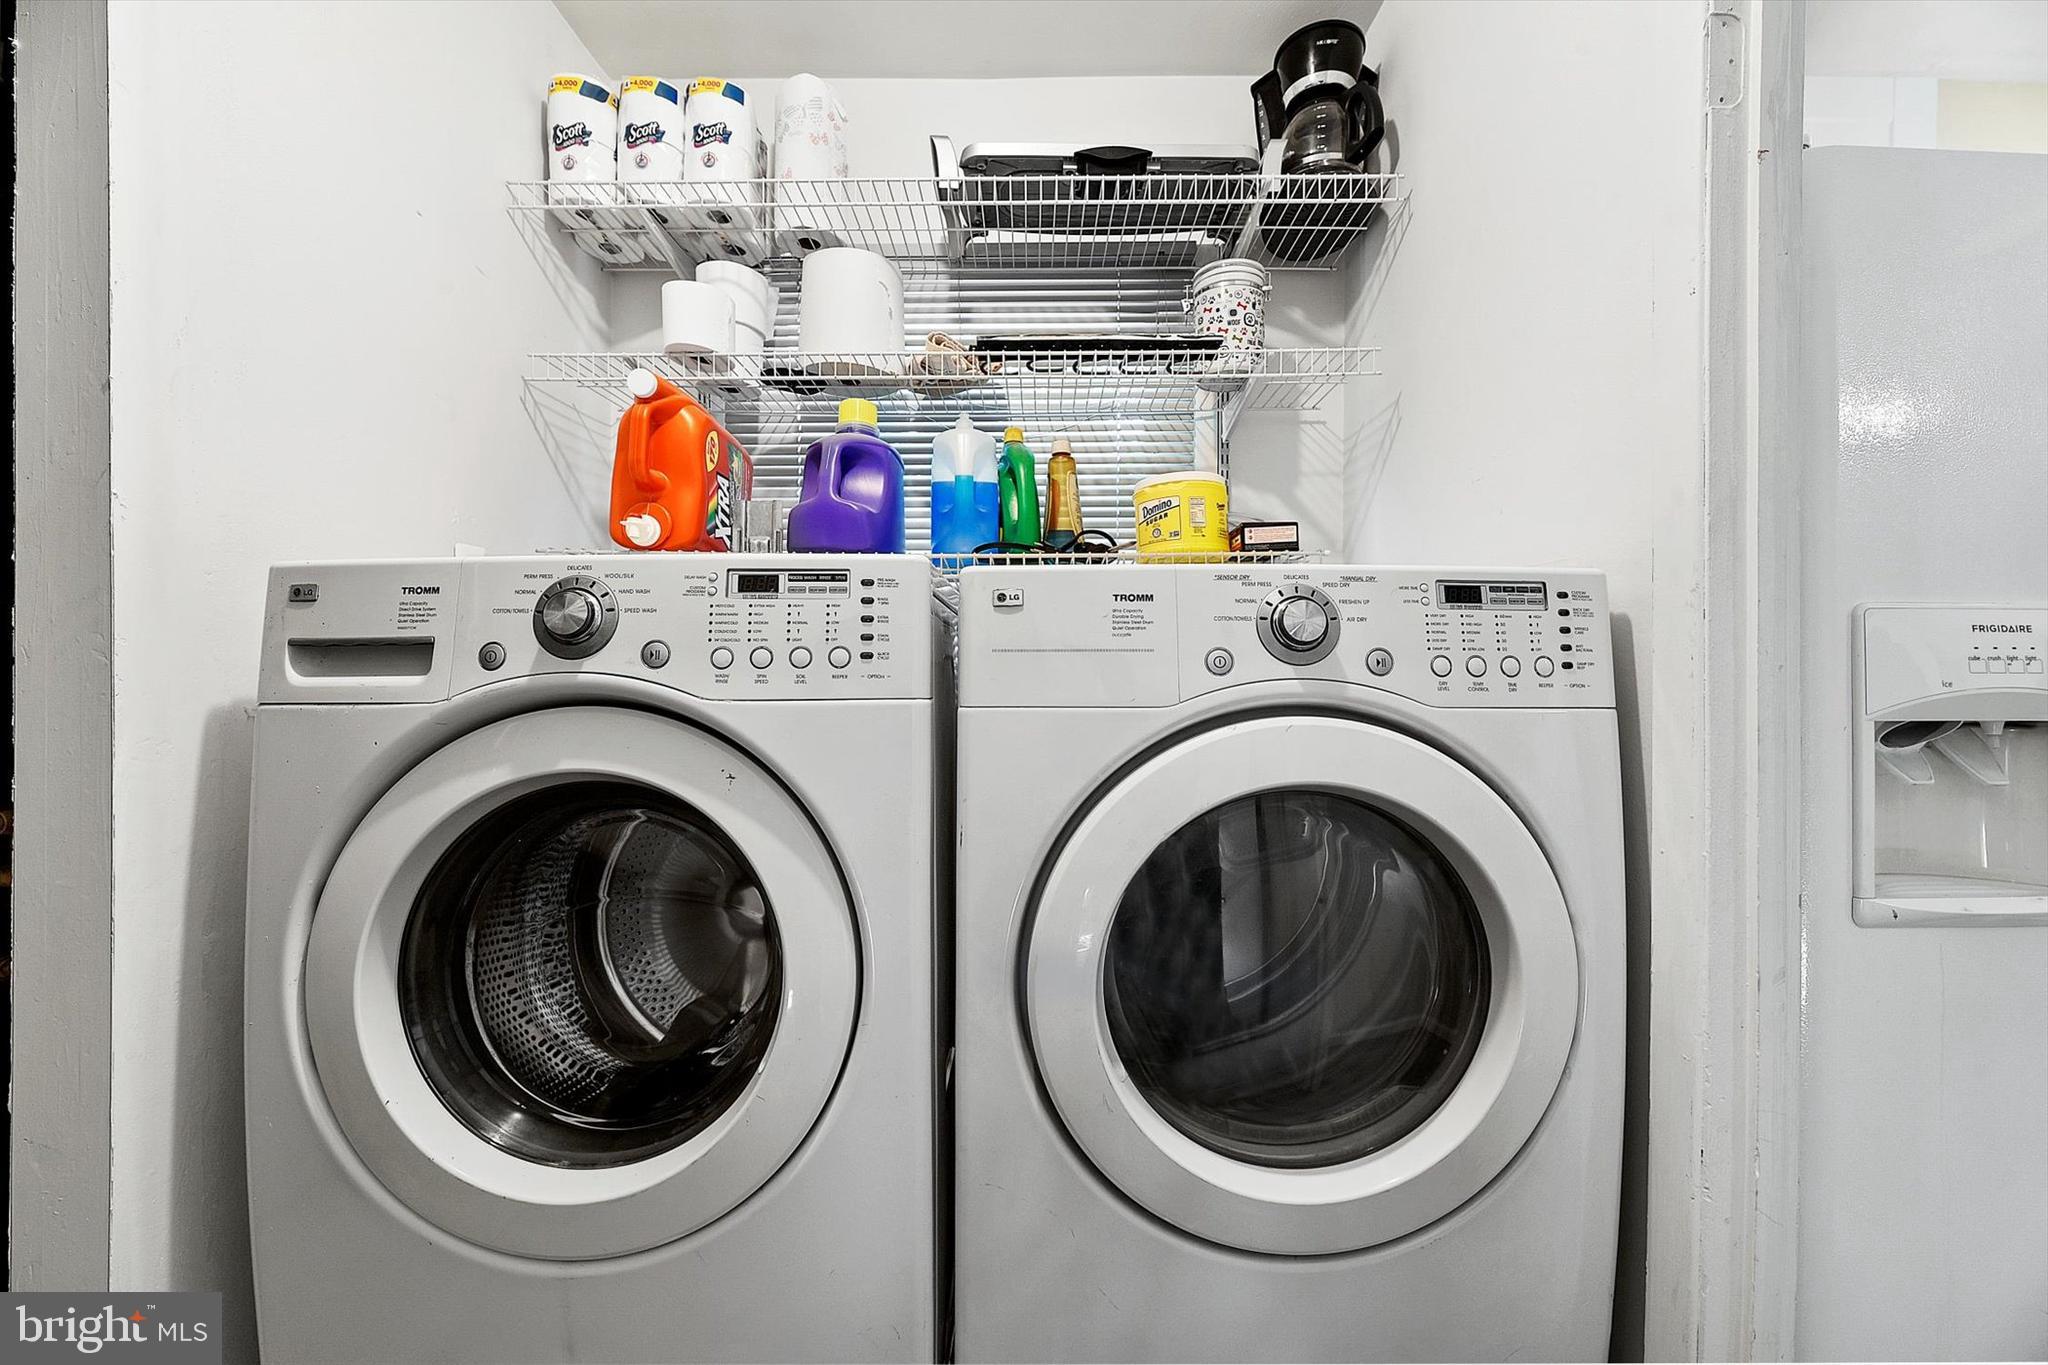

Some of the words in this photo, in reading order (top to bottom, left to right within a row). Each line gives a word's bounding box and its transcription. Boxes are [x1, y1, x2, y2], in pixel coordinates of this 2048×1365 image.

[556, 123, 584, 144] Scott
[628, 121, 658, 142] Scott
[696, 122, 726, 142] Scott
[715, 473, 732, 551] XTRA
[1142, 499, 1172, 519] Domino
[1145, 512, 1169, 526] SUGAR
[401, 586, 440, 595] TROMM
[1112, 594, 1154, 602] TROMM
[1971, 624, 2033, 633] FRIGIDAIRE
[1941, 680, 1953, 688] ice
